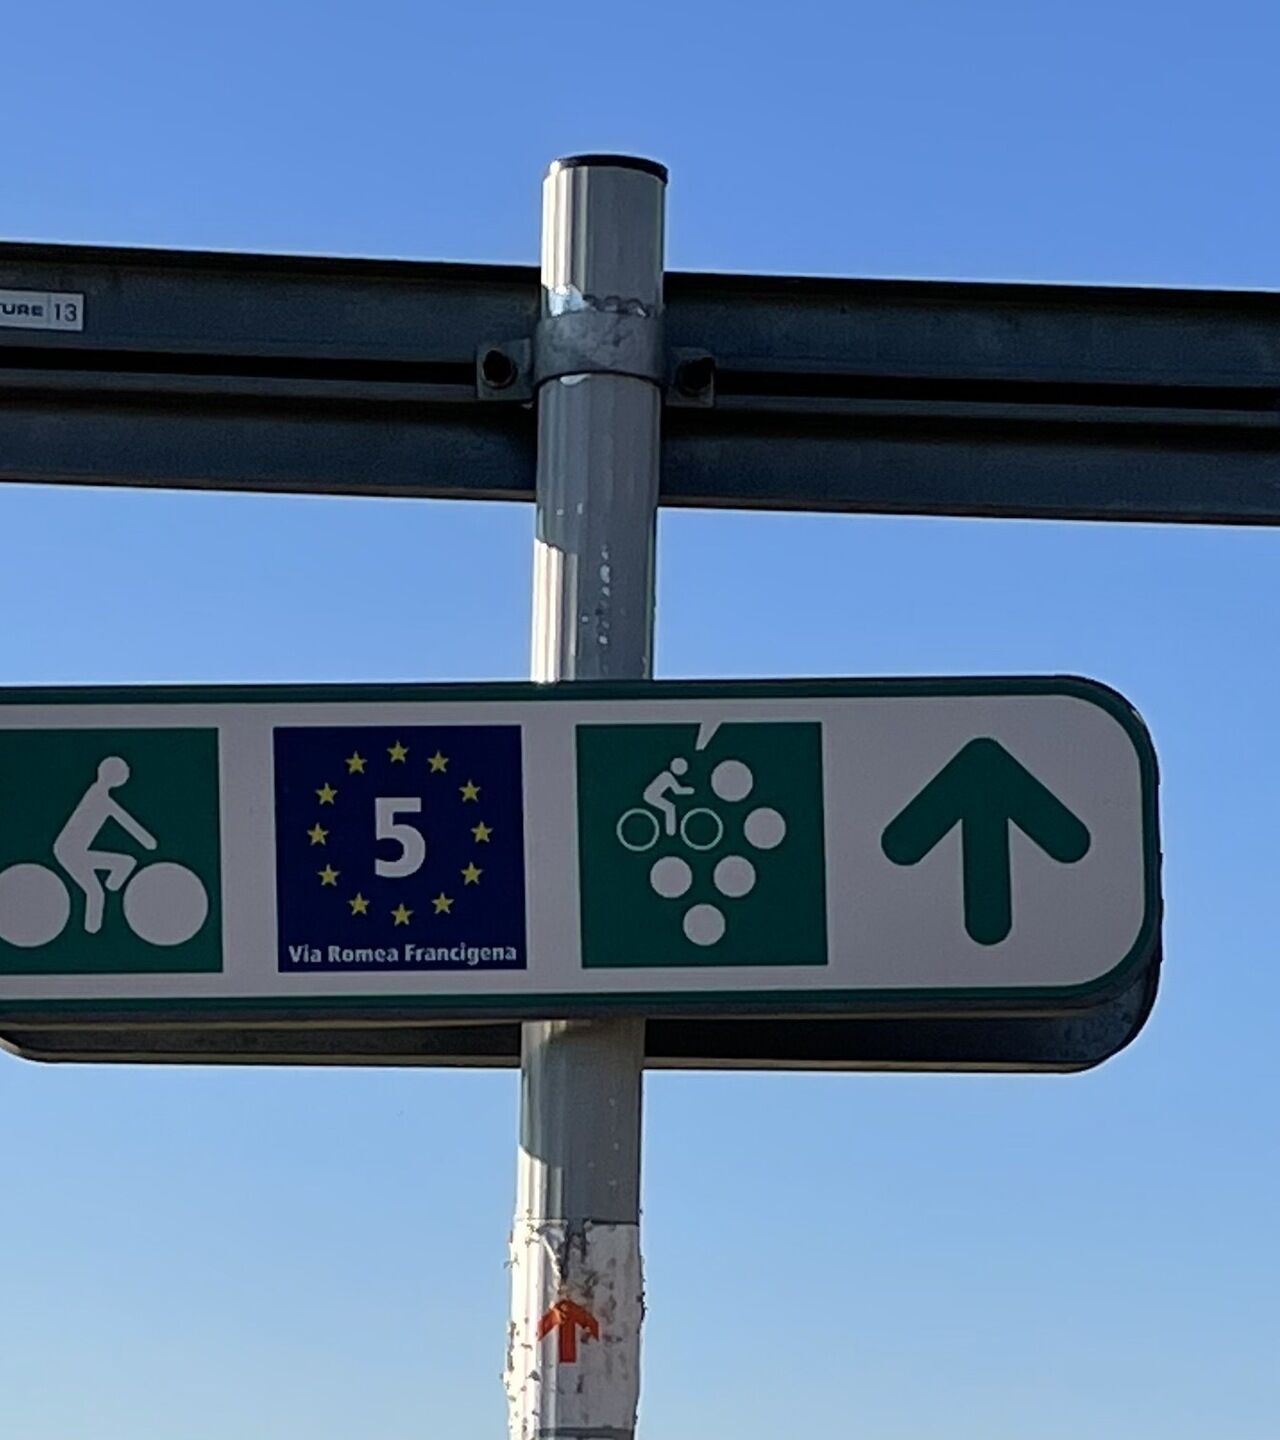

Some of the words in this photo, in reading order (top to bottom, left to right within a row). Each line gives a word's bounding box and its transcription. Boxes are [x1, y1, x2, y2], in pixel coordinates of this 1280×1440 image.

[54, 303, 78, 322] 13
[374, 797, 427, 878] 5
[288, 944, 322, 963] Via
[327, 945, 399, 962] Romea
[404, 942, 517, 965] Francigena
